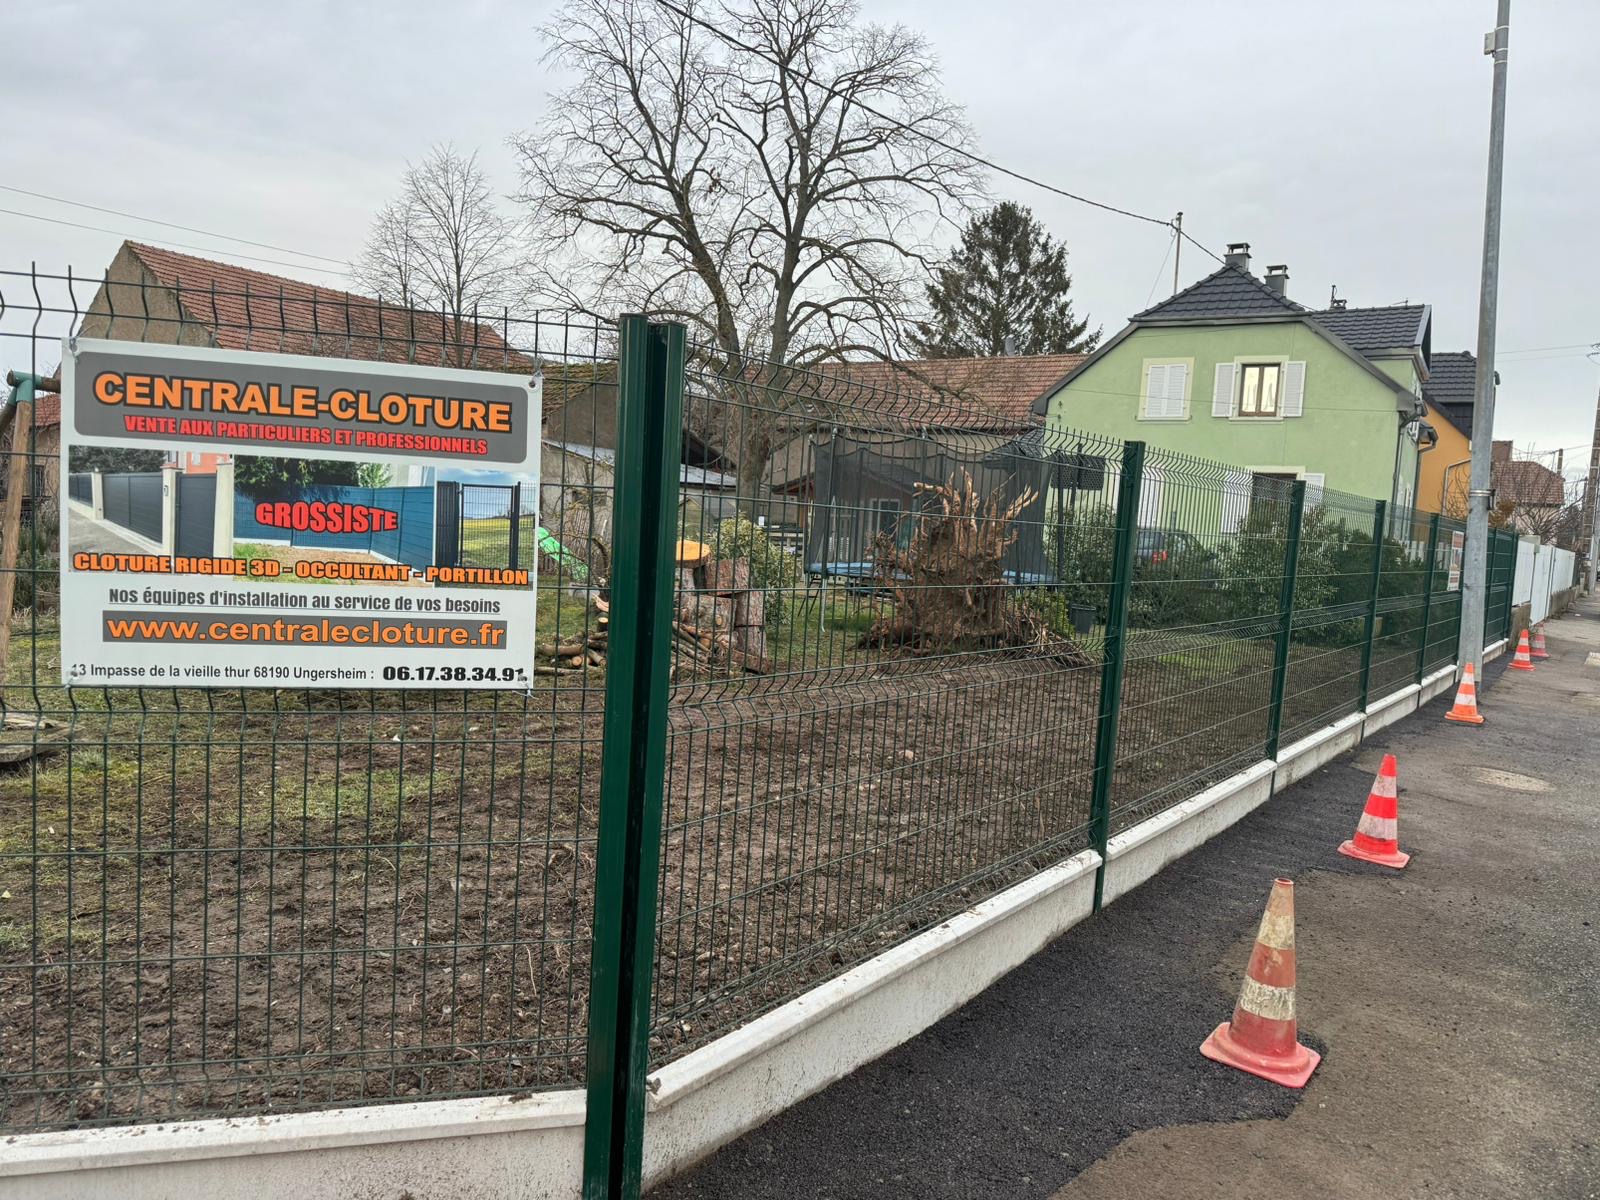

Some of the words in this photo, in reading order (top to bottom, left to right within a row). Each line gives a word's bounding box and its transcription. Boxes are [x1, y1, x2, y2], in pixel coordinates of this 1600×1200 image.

[92, 371, 513, 434] CENTRALE-CLOTURE
[124, 415, 177, 434] VENTE
[179, 418, 214, 437] AUX
[217, 421, 332, 445] PARTICULIERS
[335, 429, 353, 446] ET
[356, 431, 488, 455] PROFESSIONNELS
[254, 501, 399, 533] GROSSISTE
[73, 552, 171, 574] CLOTURE
[174, 556, 247, 576] RIGIDE
[250, 559, 280, 577] 3D
[295, 561, 412, 582] OCCULTANT
[425, 566, 529, 586] PORTILLON
[109, 588, 138, 603] Nos
[143, 587, 205, 606] équipes
[210, 590, 308, 608] d'installation
[312, 595, 330, 609] au
[334, 596, 390, 610] service
[395, 596, 412, 611] de
[416, 599, 441, 612] vos
[446, 597, 501, 614] besoins
[107, 618, 505, 646] www.centralecloture.fr
[91, 664, 146, 679] Impasse
[150, 664, 166, 677] de
[169, 665, 180, 677] la
[184, 665, 221, 678] vieille
[224, 666, 250, 678] thur
[254, 666, 290, 679] 68190
[294, 667, 367, 682] Ungersheim
